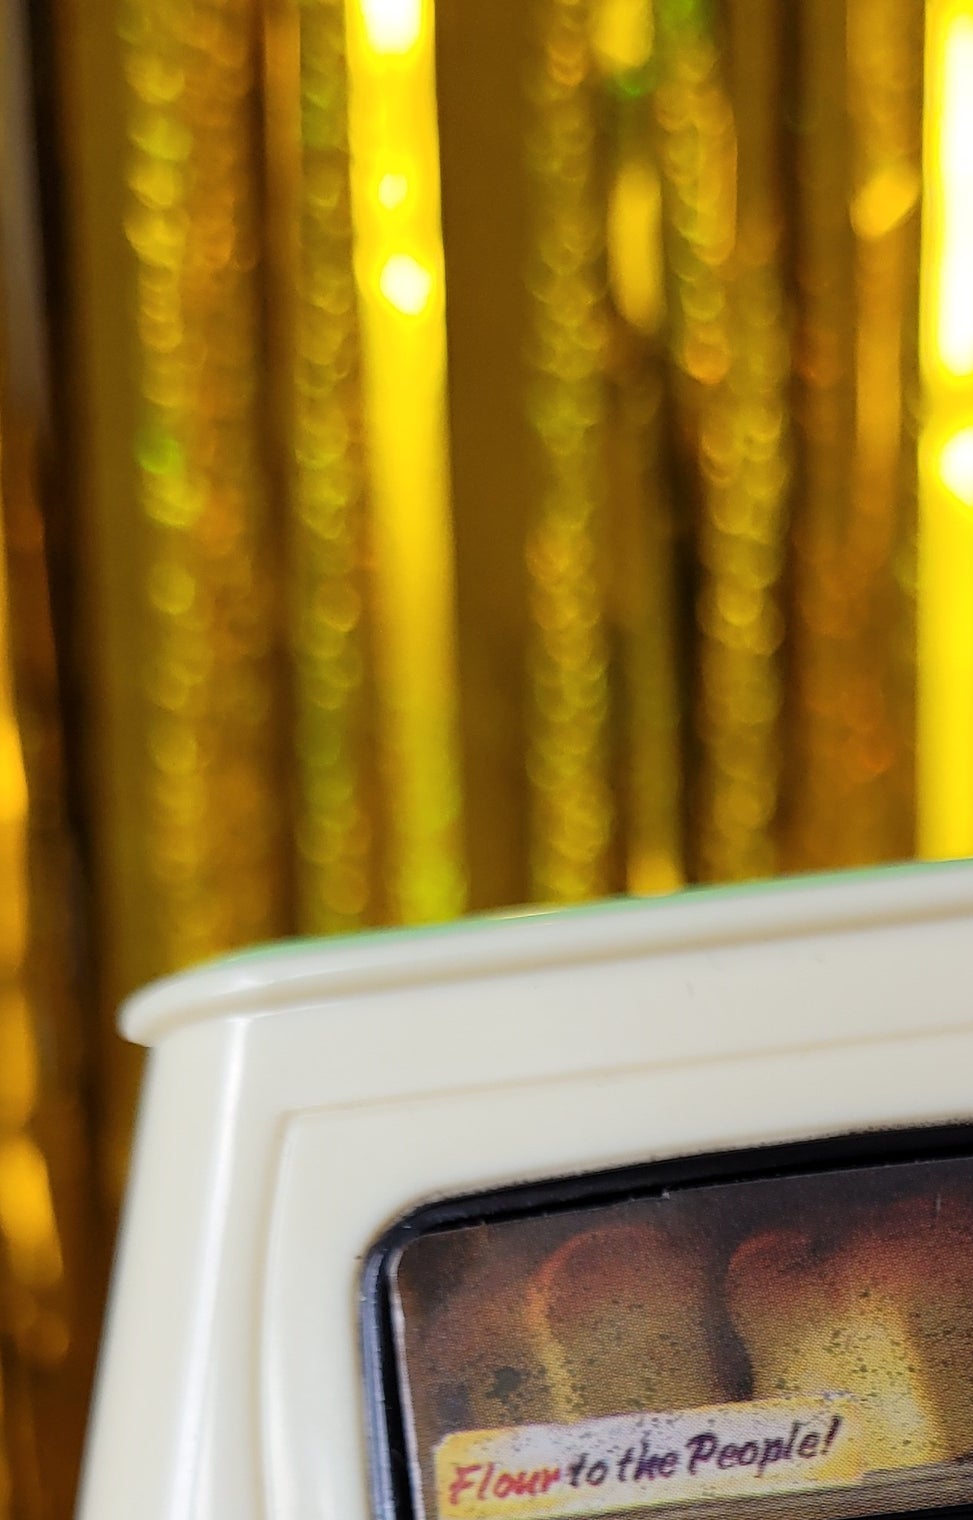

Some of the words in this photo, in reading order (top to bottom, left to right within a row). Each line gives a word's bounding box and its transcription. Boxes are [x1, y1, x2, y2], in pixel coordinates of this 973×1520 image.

[449, 1463, 561, 1504] Flour
[567, 1452, 607, 1488] to
[616, 1432, 678, 1482] the
[686, 1415, 842, 1478] People!
